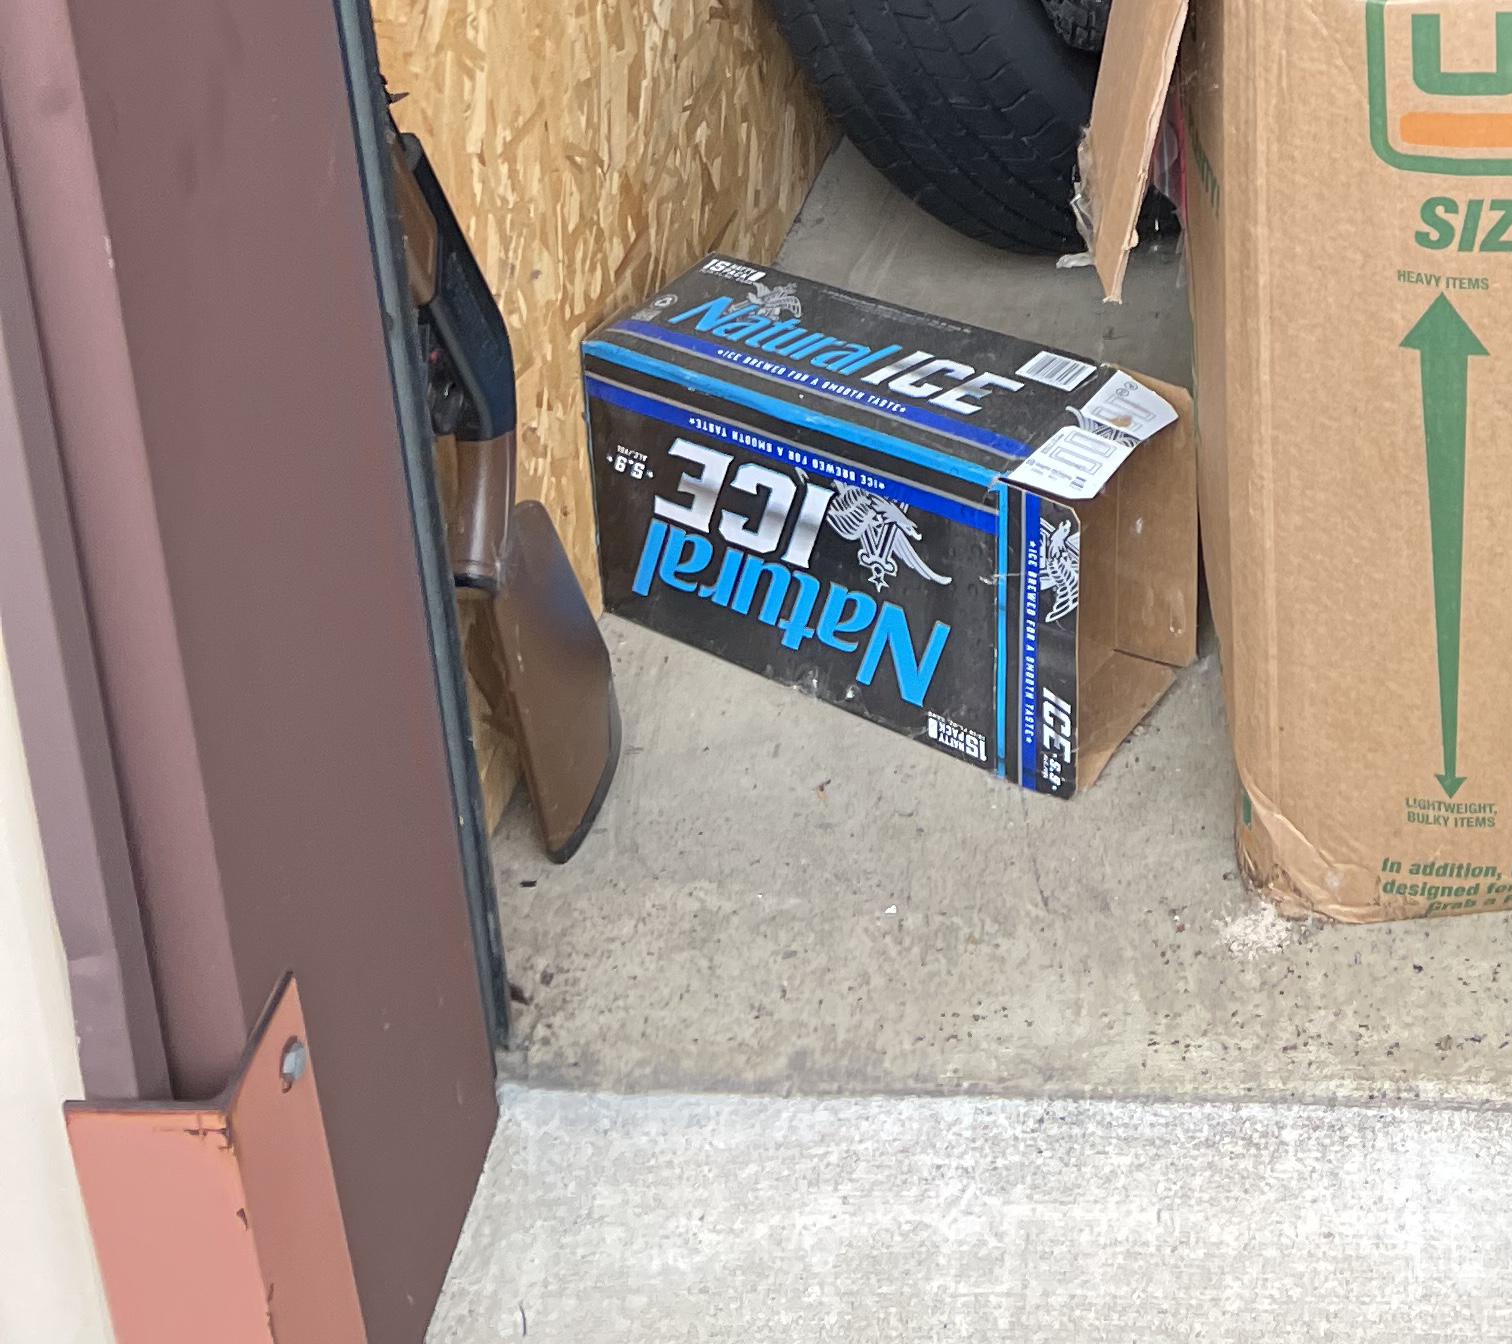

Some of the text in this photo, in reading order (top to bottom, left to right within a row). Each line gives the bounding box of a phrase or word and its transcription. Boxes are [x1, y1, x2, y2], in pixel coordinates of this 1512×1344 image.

[1397, 269, 1489, 291] HEAVY ITEMS
[668, 296, 902, 376] Natural
[860, 350, 1025, 415] ICE
[742, 355, 786, 376] BREWED
[790, 370, 809, 383] FOR
[821, 380, 864, 403] SMOOTH
[867, 393, 900, 413] TASTE
[696, 418, 728, 439] TASTE
[731, 430, 772, 454] SMOOTH
[788, 450, 808, 466] FOR
[812, 457, 856, 482] BREWED
[654, 437, 837, 569] ICE
[632, 521, 951, 709] Natural
[938, 720, 964, 741] PACK
[1043, 687, 1073, 764] ICE
[938, 732, 987, 762] 15 NATTY
[1405, 797, 1498, 815] LIGHTWEIGHT,
[1407, 811, 1497, 828] BULKY ITEMS
[1381, 857, 1402, 873] In
[1409, 859, 1503, 881] addition,
